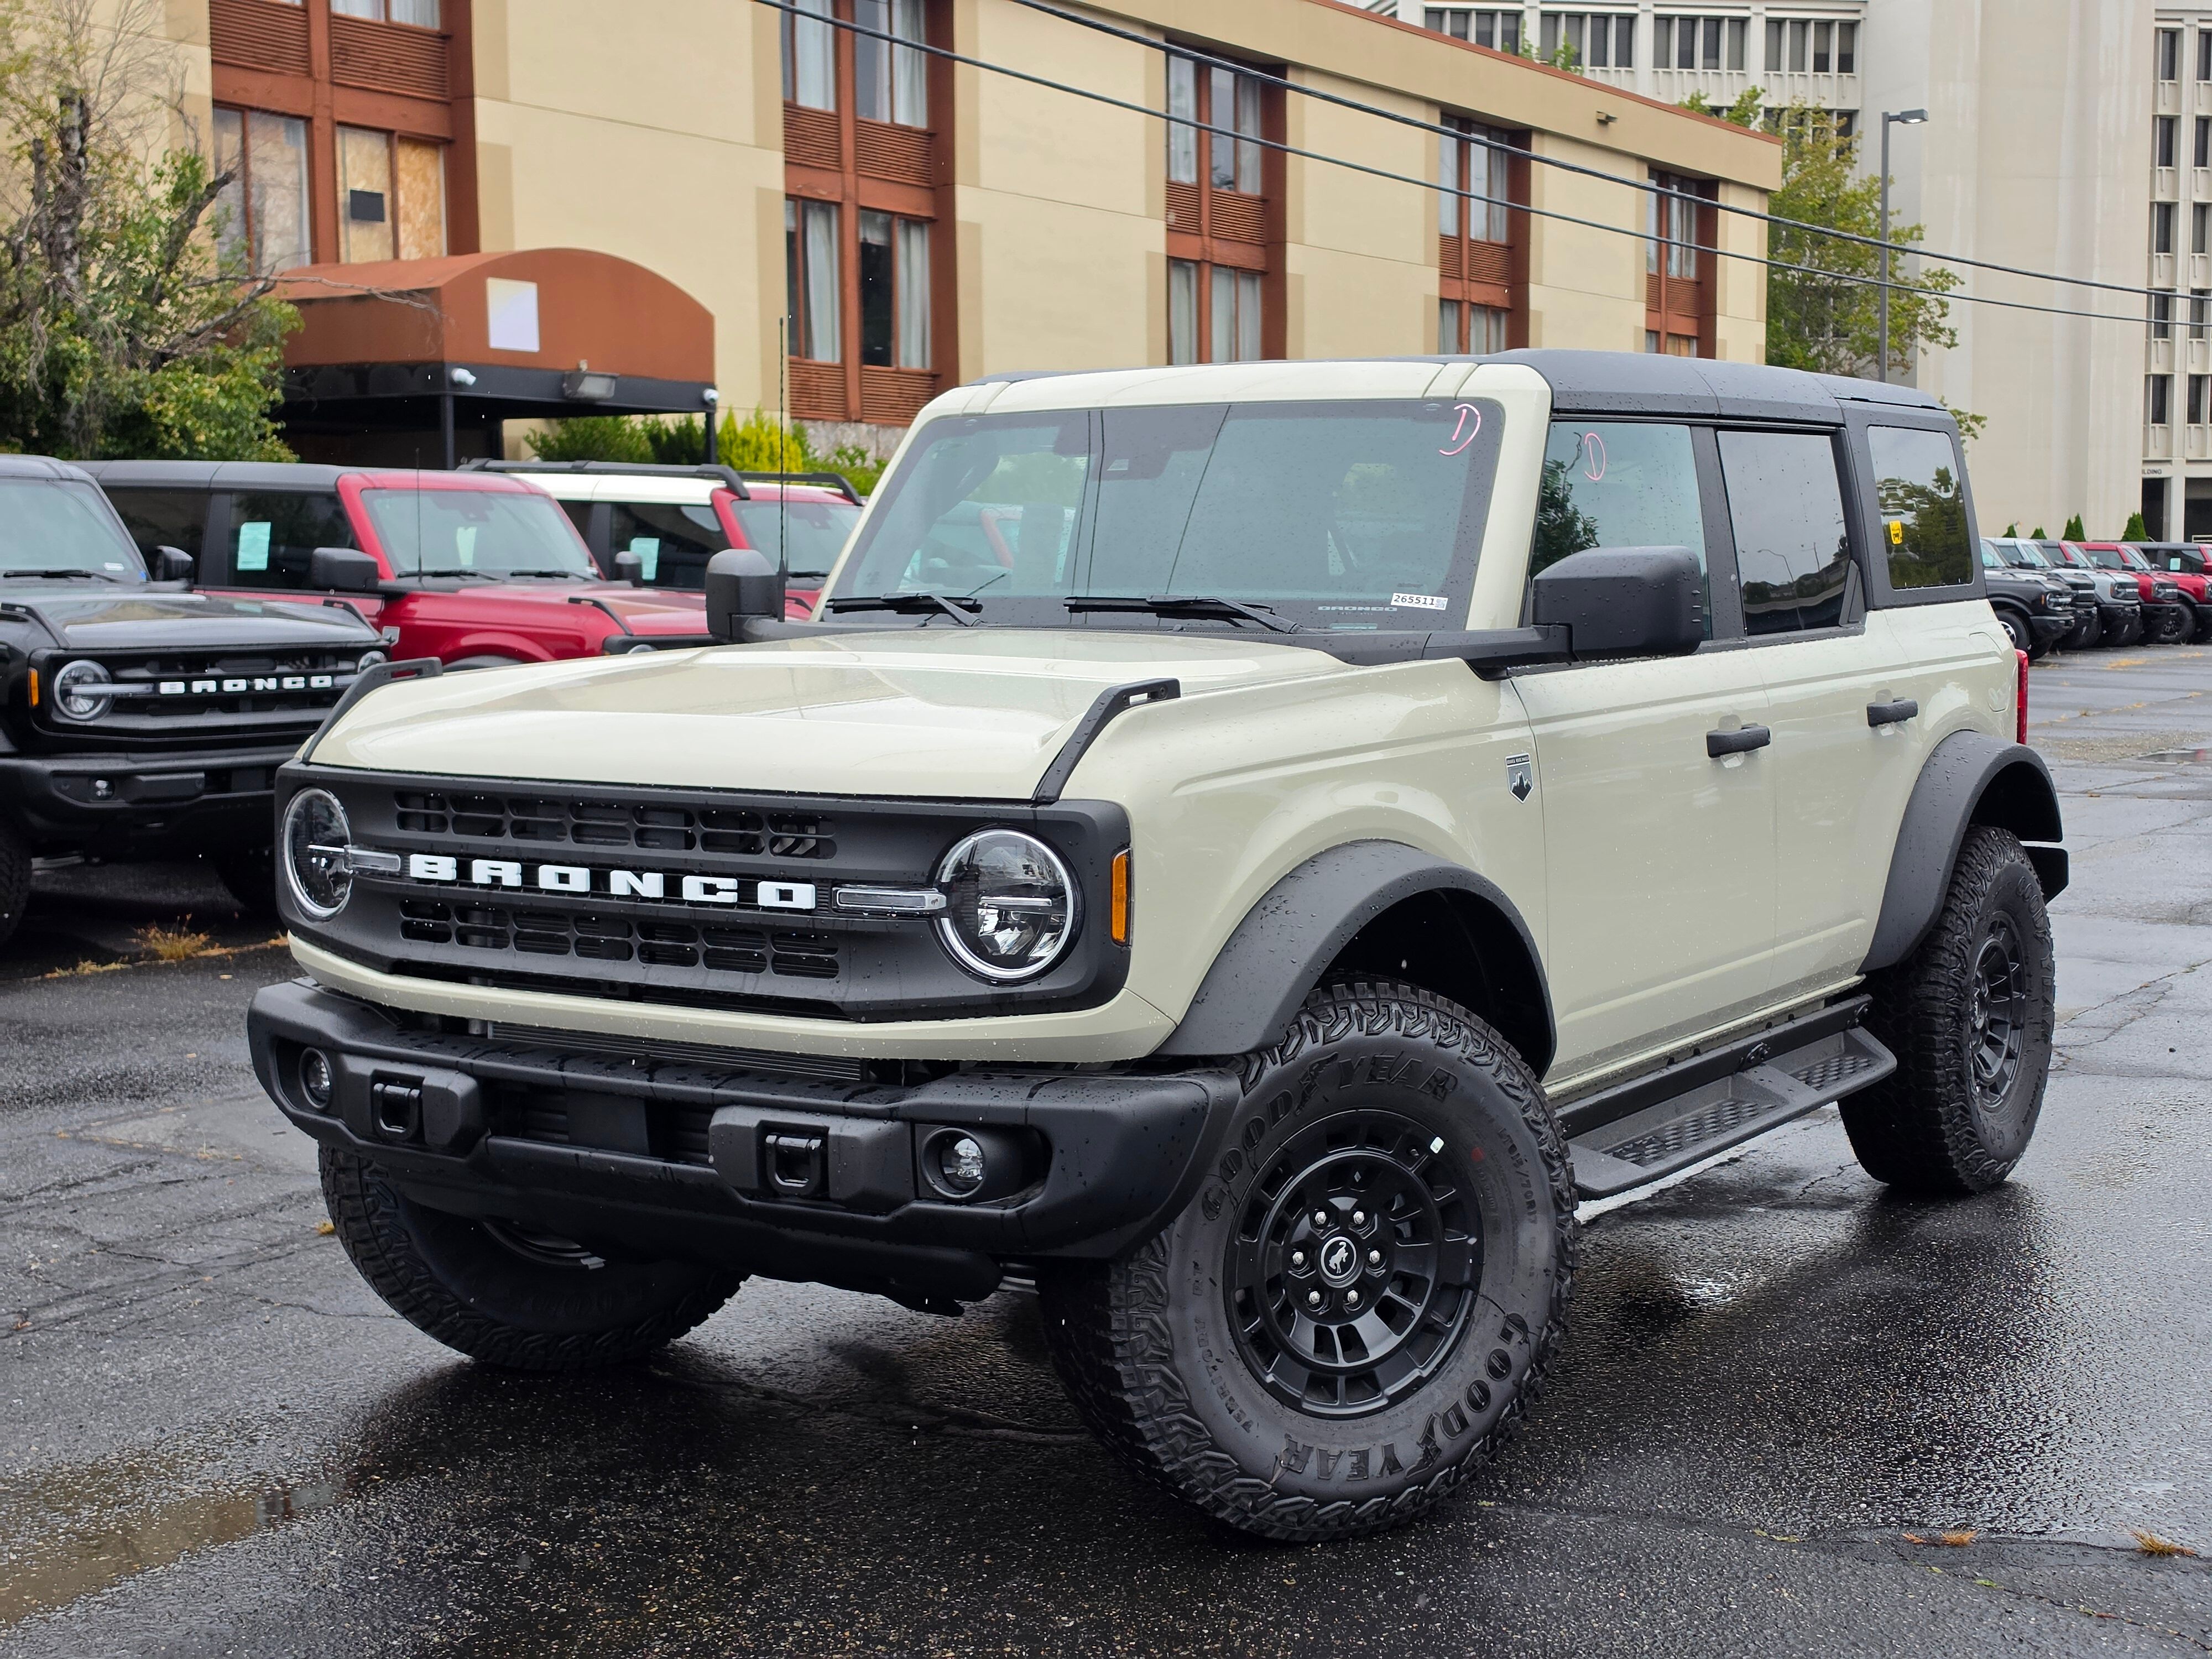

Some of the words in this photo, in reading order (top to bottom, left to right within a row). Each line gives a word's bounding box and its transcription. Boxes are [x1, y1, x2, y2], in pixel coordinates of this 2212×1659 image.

[1439, 404, 1481, 456] D
[1584, 433, 1605, 481] D
[1394, 595, 1435, 606] 265511
[160, 676, 332, 693] BRONCO
[410, 853, 816, 910] BRONCO
